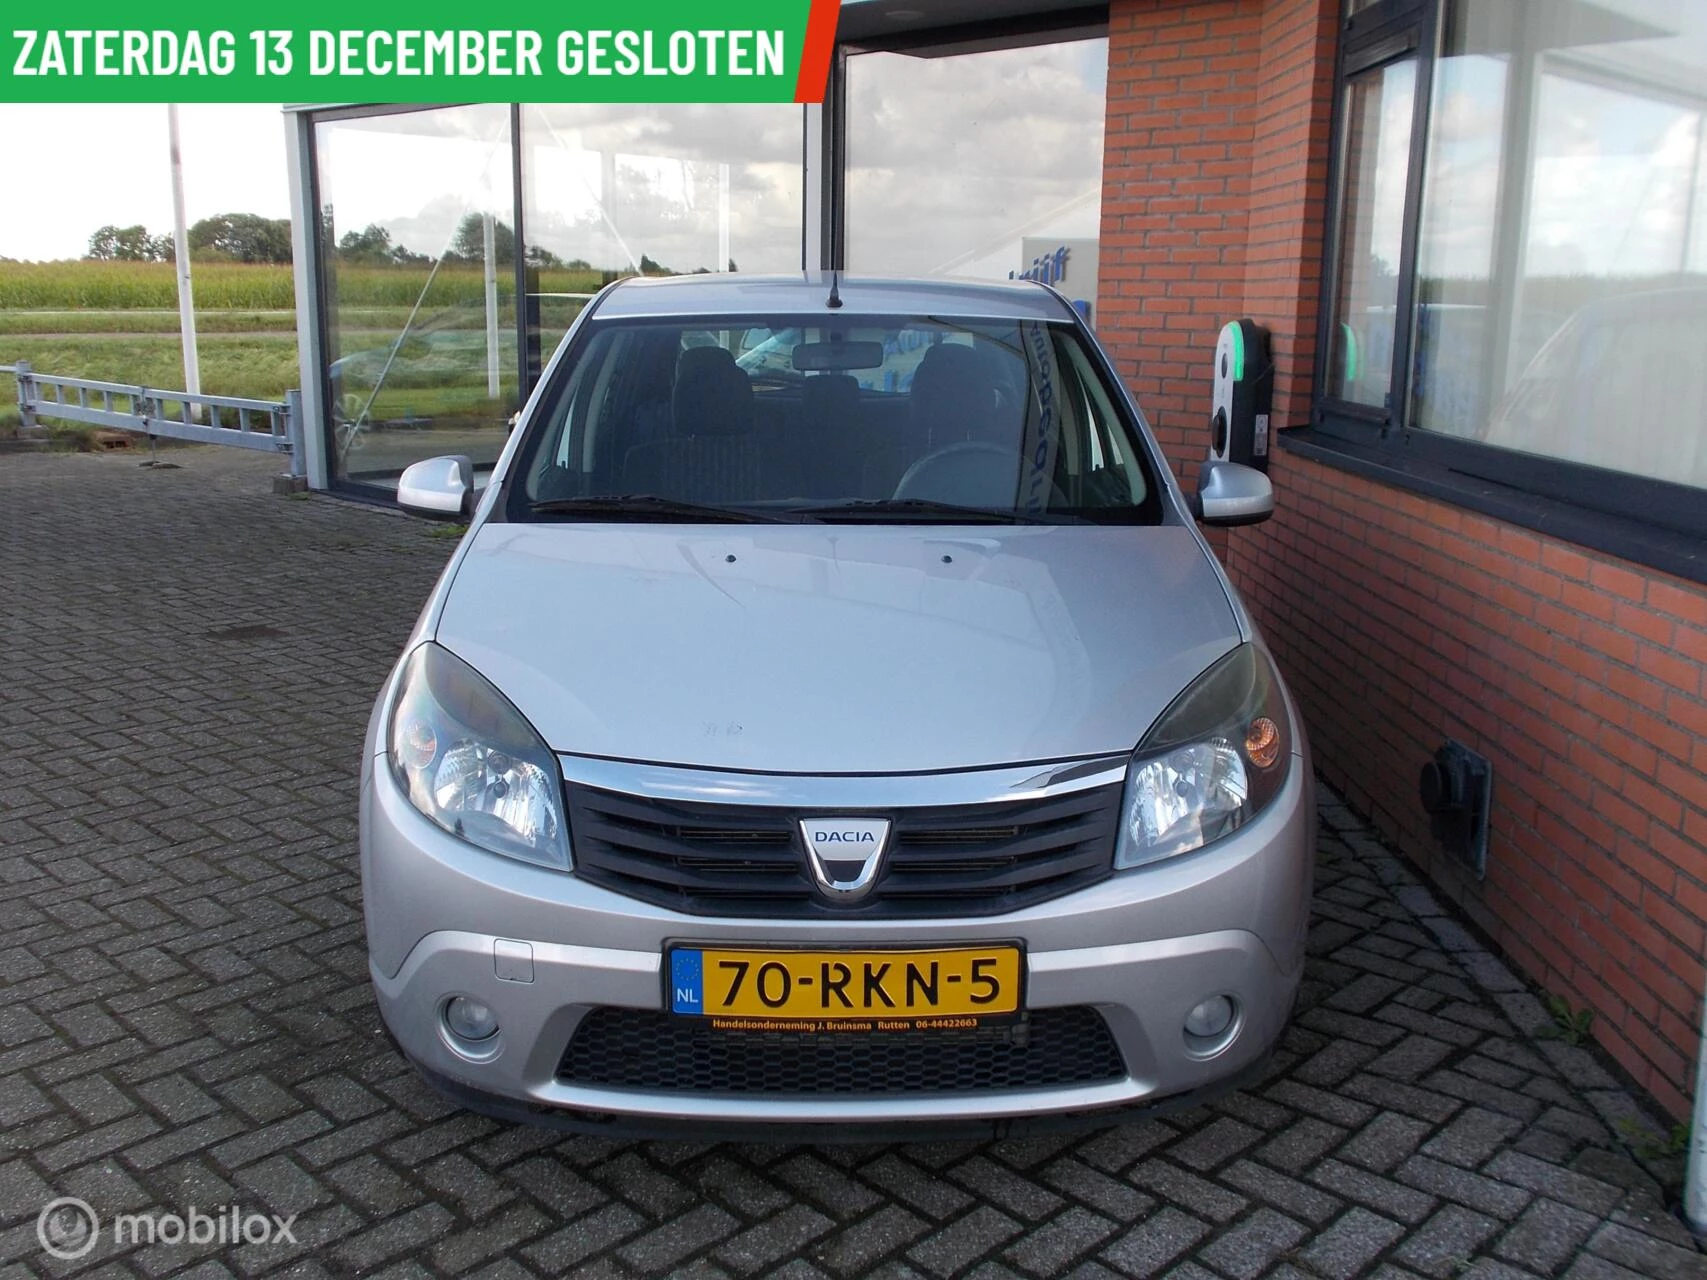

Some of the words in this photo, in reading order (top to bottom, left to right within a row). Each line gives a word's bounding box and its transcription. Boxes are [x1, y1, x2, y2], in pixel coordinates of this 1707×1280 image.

[815, 831, 875, 842] DACIA
[676, 988, 699, 1003] NL
[718, 958, 1001, 1008] 70-RKN-5
[712, 1019, 816, 1032] Handelsonderneming
[817, 1021, 825, 1030] J.
[826, 1020, 872, 1031] Bruinsma
[877, 1020, 910, 1030] Rutten
[915, 1018, 978, 1030] 06-44422663
